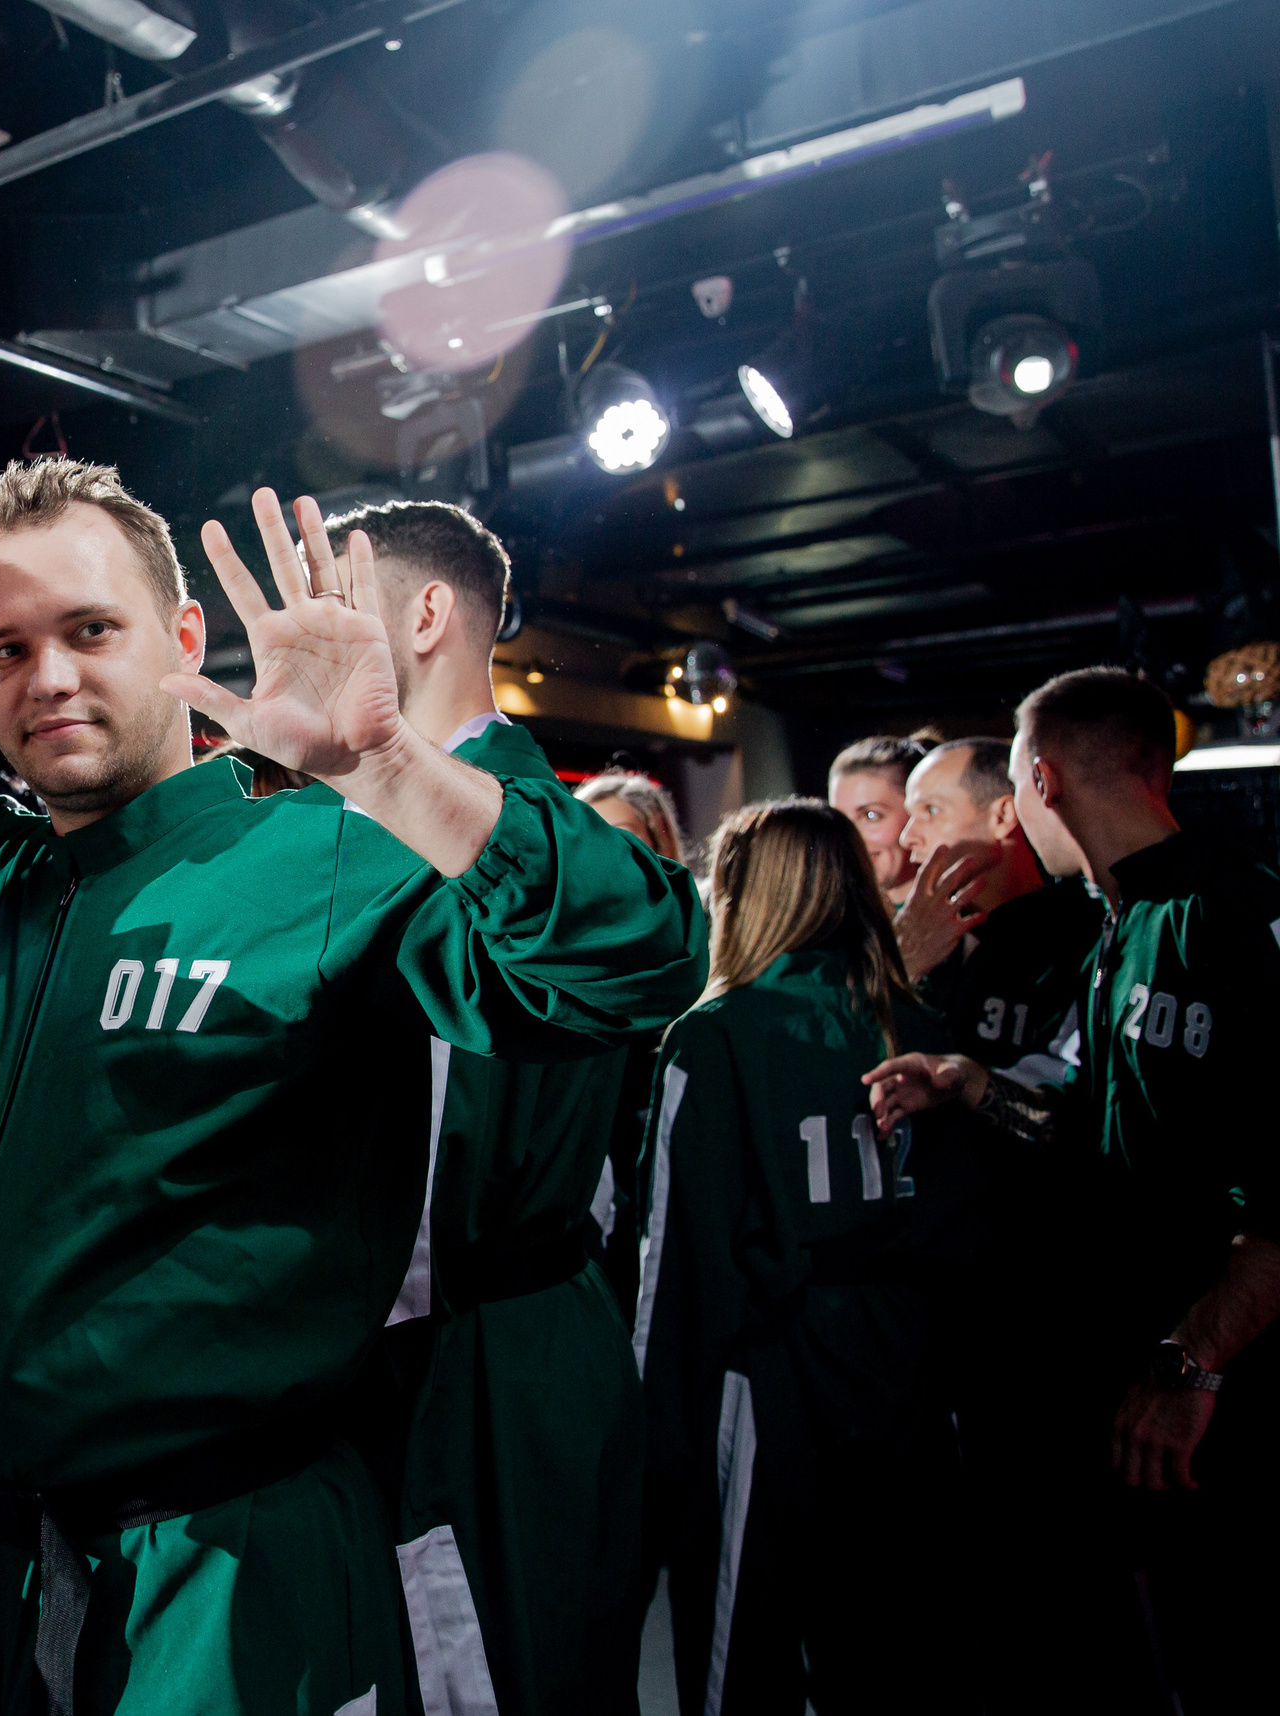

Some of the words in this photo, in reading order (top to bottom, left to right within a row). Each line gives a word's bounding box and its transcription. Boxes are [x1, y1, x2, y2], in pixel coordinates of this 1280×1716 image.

[99, 958, 231, 1033] 017
[976, 996, 1038, 1046] 31
[1123, 983, 1213, 1059] 208
[799, 1113, 916, 1203] 112
